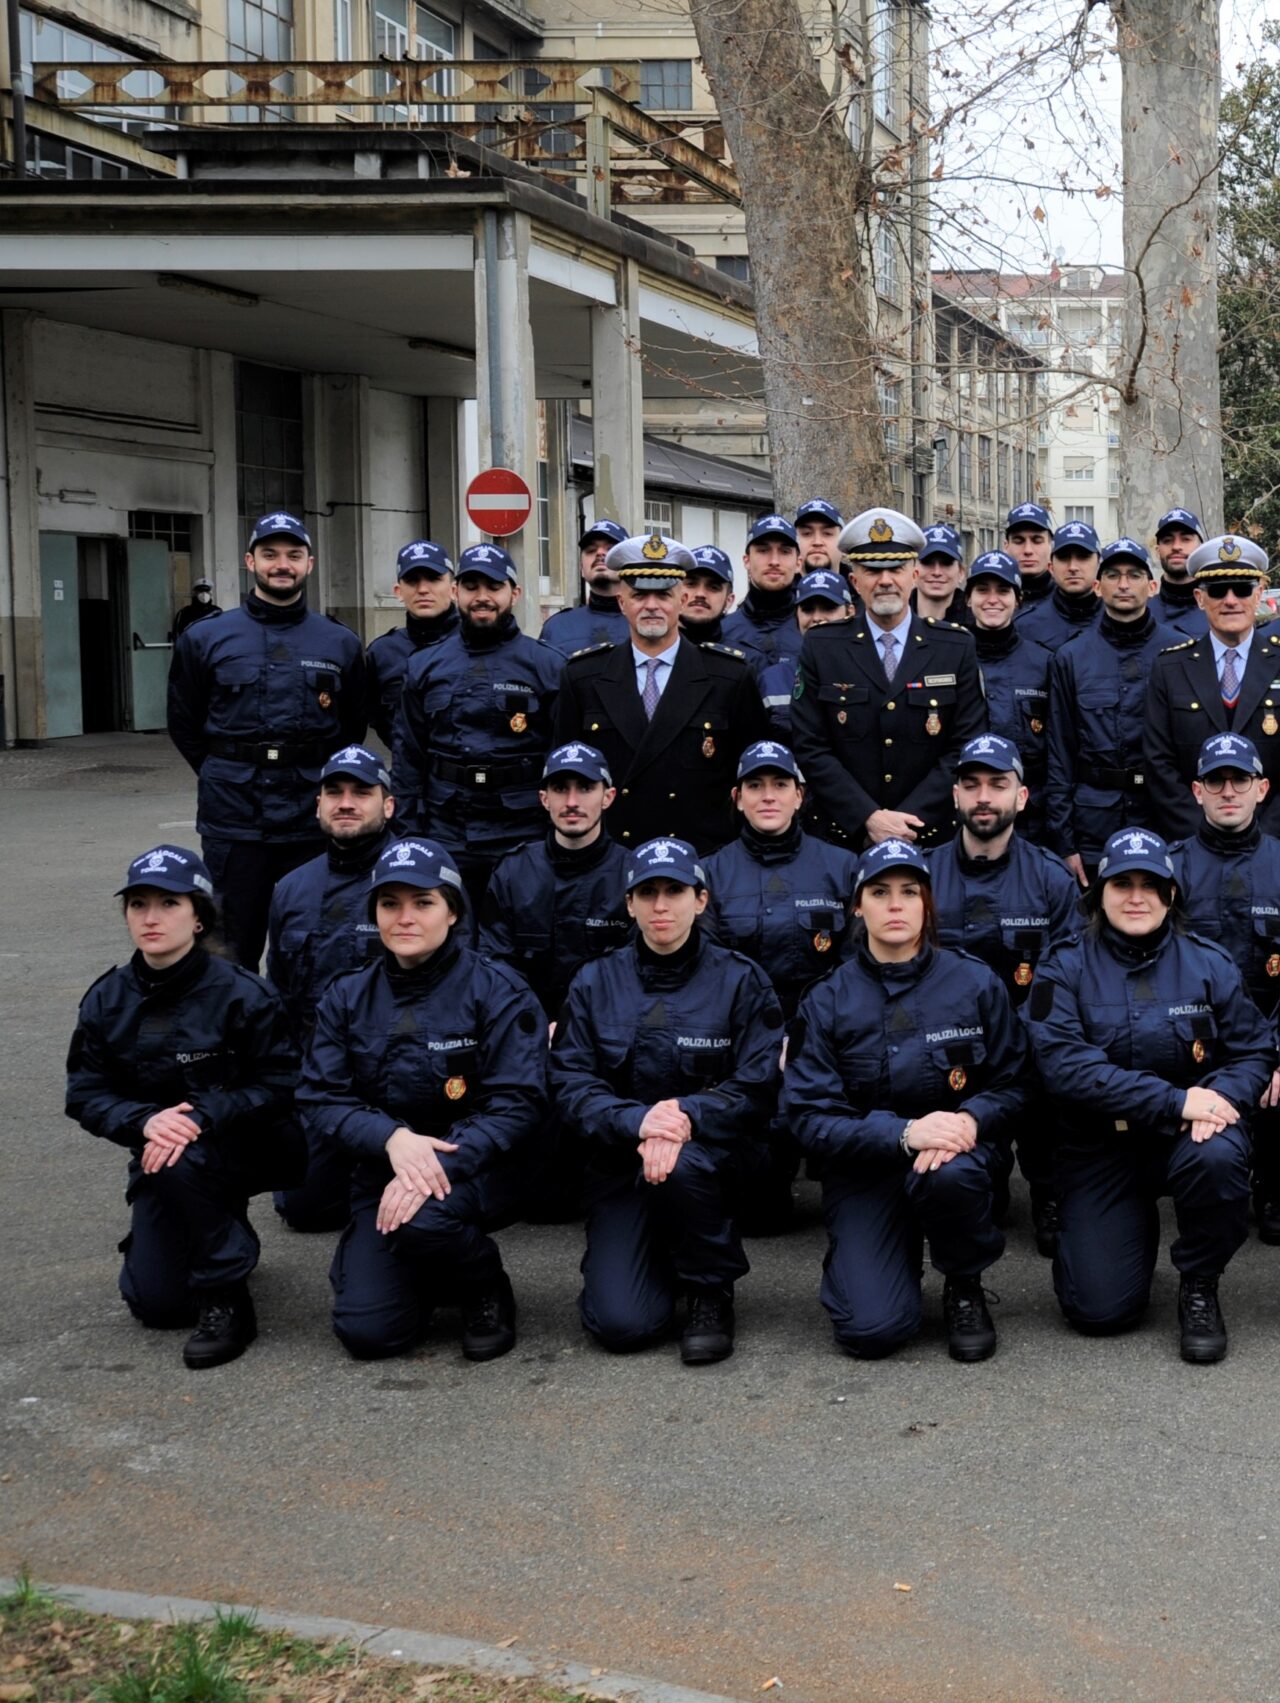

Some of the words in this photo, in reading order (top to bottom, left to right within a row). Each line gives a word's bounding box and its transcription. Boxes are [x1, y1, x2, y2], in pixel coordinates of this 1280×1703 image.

[301, 660, 327, 669] POLIZIA
[492, 683, 519, 691] POLIZIA
[794, 898, 824, 908] POLIZIA
[1250, 905, 1279, 916] POLIZIA
[1000, 917, 1029, 926] POLIZIA
[1169, 1004, 1198, 1016] POLIZIA
[926, 1029, 958, 1042] POLIZIA
[428, 1039, 462, 1051] POLIZIA
[677, 1036, 711, 1048] POLIZIA
